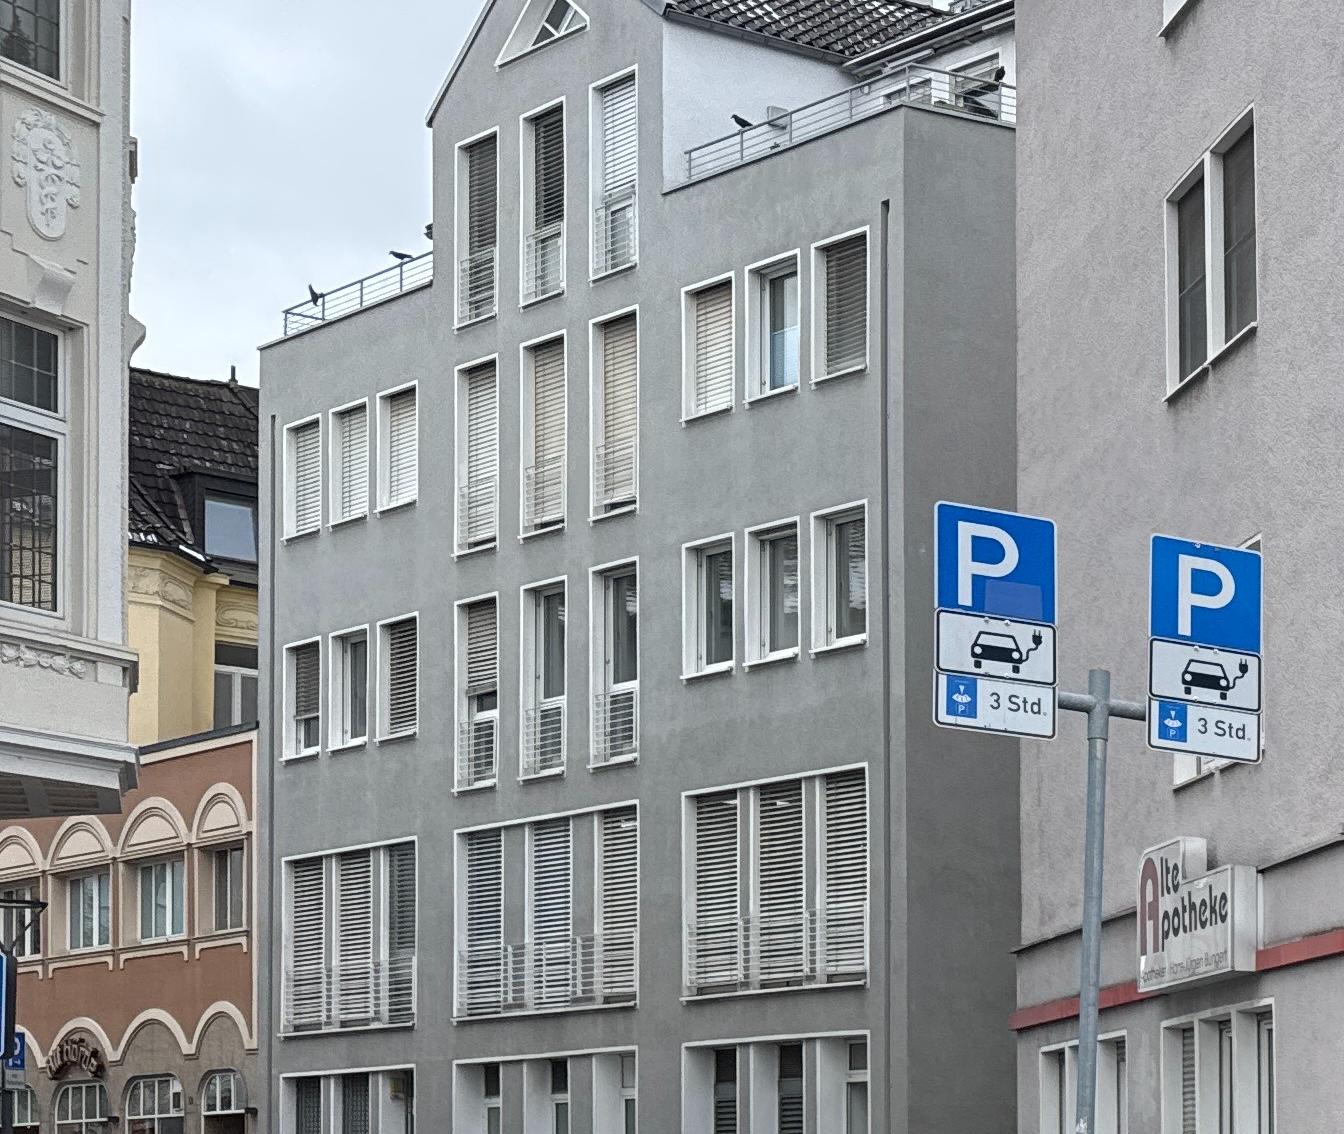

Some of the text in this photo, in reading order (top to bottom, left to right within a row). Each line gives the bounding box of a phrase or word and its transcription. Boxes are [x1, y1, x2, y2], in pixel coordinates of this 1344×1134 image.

[957, 521, 1019, 606] P
[1178, 554, 1235, 636] P
[990, 692, 1001, 710] 3
[1197, 718, 1207, 734] 3
